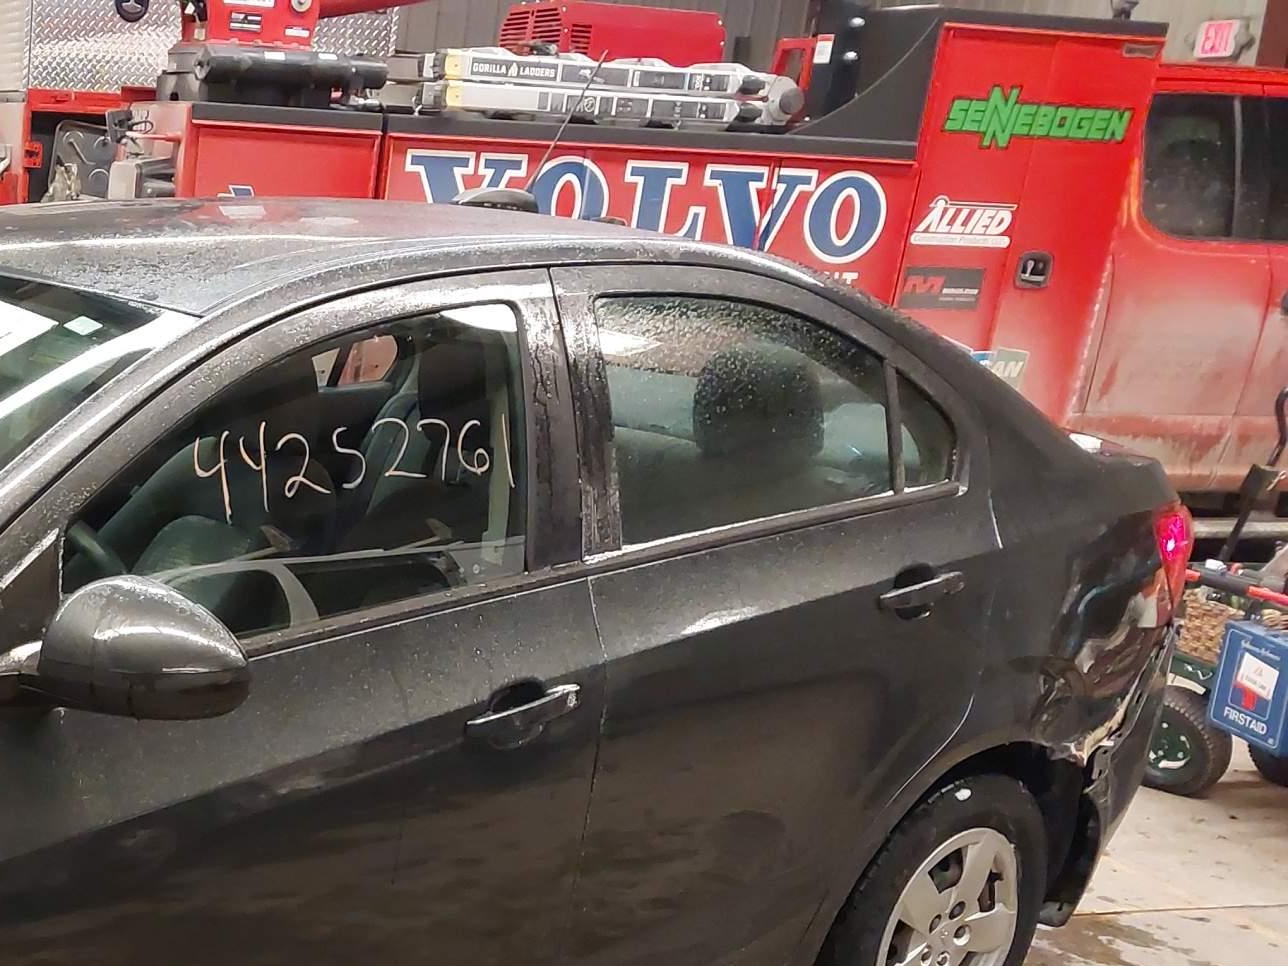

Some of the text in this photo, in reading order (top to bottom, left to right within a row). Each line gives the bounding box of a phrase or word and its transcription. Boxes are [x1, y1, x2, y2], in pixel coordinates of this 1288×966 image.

[472, 62, 556, 78] GORILLA LADDERS
[405, 148, 887, 264] VOLVO
[915, 204, 1013, 235] ALLIED
[192, 413, 516, 525] 44252761
